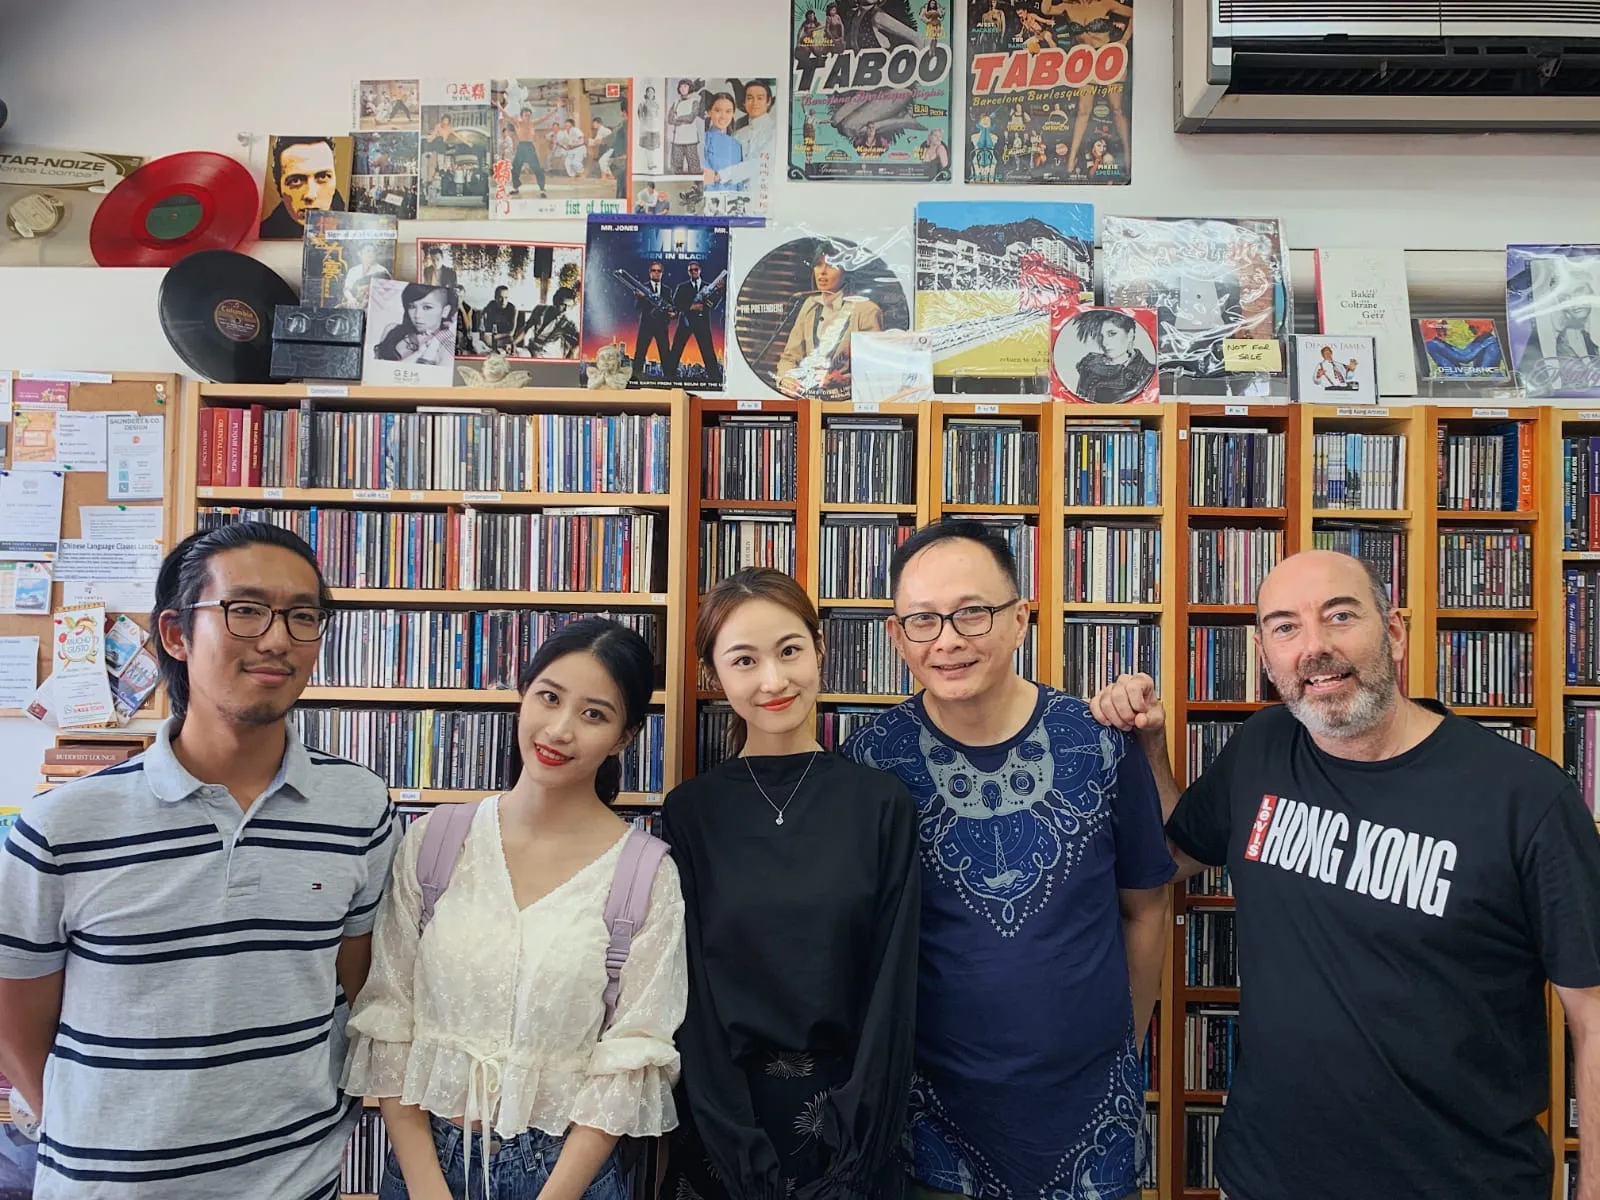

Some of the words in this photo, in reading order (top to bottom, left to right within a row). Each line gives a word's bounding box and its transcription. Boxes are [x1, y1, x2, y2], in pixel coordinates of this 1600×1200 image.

[794, 47, 949, 92] TABOO
[973, 46, 1125, 91] TABOO
[972, 95, 1024, 107] Barcelona
[1027, 90, 1087, 102] Burlesque
[1090, 84, 1124, 97] Nights
[565, 199, 581, 215] fist
[586, 199, 595, 215] of
[600, 199, 620, 214] fury
[615, 224, 639, 232] JONES
[665, 252, 676, 260] IN
[678, 252, 707, 261] BLACK
[1351, 289, 1375, 298] Baker
[750, 303, 784, 314] PRETENDERS
[1340, 300, 1378, 309] Coltrane
[1361, 310, 1385, 320] Getz
[1251, 343, 1271, 351] FOR
[1237, 353, 1263, 361] SALE
[1521, 448, 1531, 469] Life
[87, 543, 115, 551] Language
[67, 645, 89, 653] GUSTO
[1260, 797, 1349, 885] HONG
[1345, 819, 1458, 918] KONG
